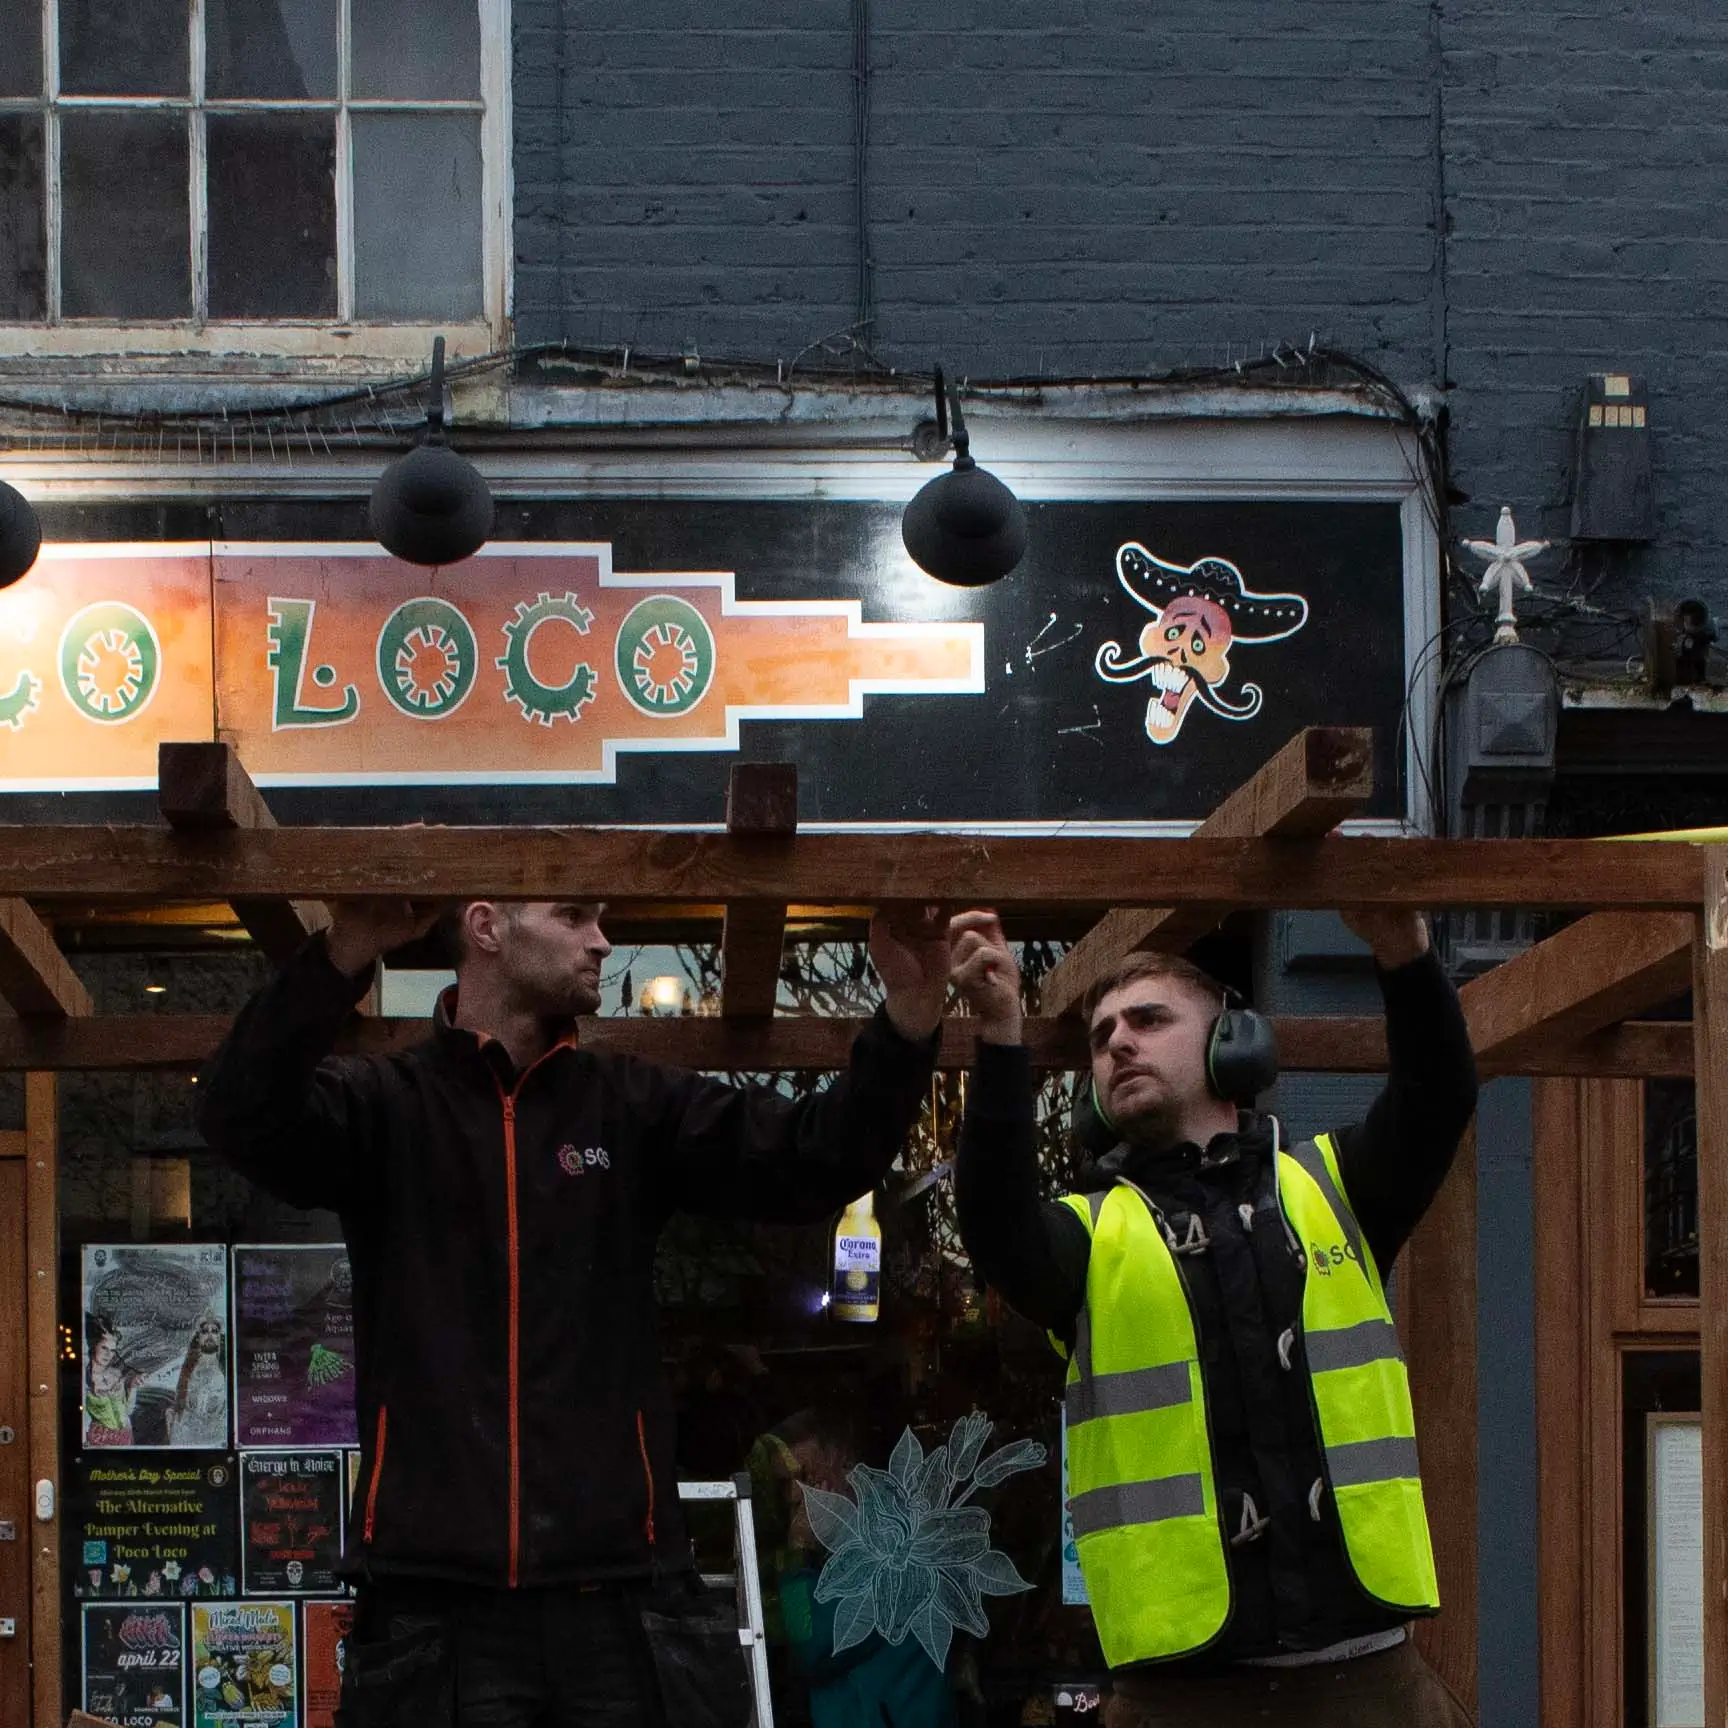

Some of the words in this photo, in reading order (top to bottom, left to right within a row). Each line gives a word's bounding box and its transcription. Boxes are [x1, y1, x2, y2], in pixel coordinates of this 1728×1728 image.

[266, 590, 717, 733] LOCO
[839, 1237, 877, 1251] Corona
[164, 1468, 202, 1484] Special
[95, 1499, 122, 1514] The
[126, 1499, 204, 1514] Alternative
[83, 1523, 139, 1540] Pamper
[141, 1521, 200, 1540] Evening
[202, 1523, 217, 1537] at
[113, 1544, 150, 1559] Poco
[151, 1544, 189, 1559] Loco
[158, 1649, 181, 1666] 22
[123, 1715, 153, 1727] LOCO
